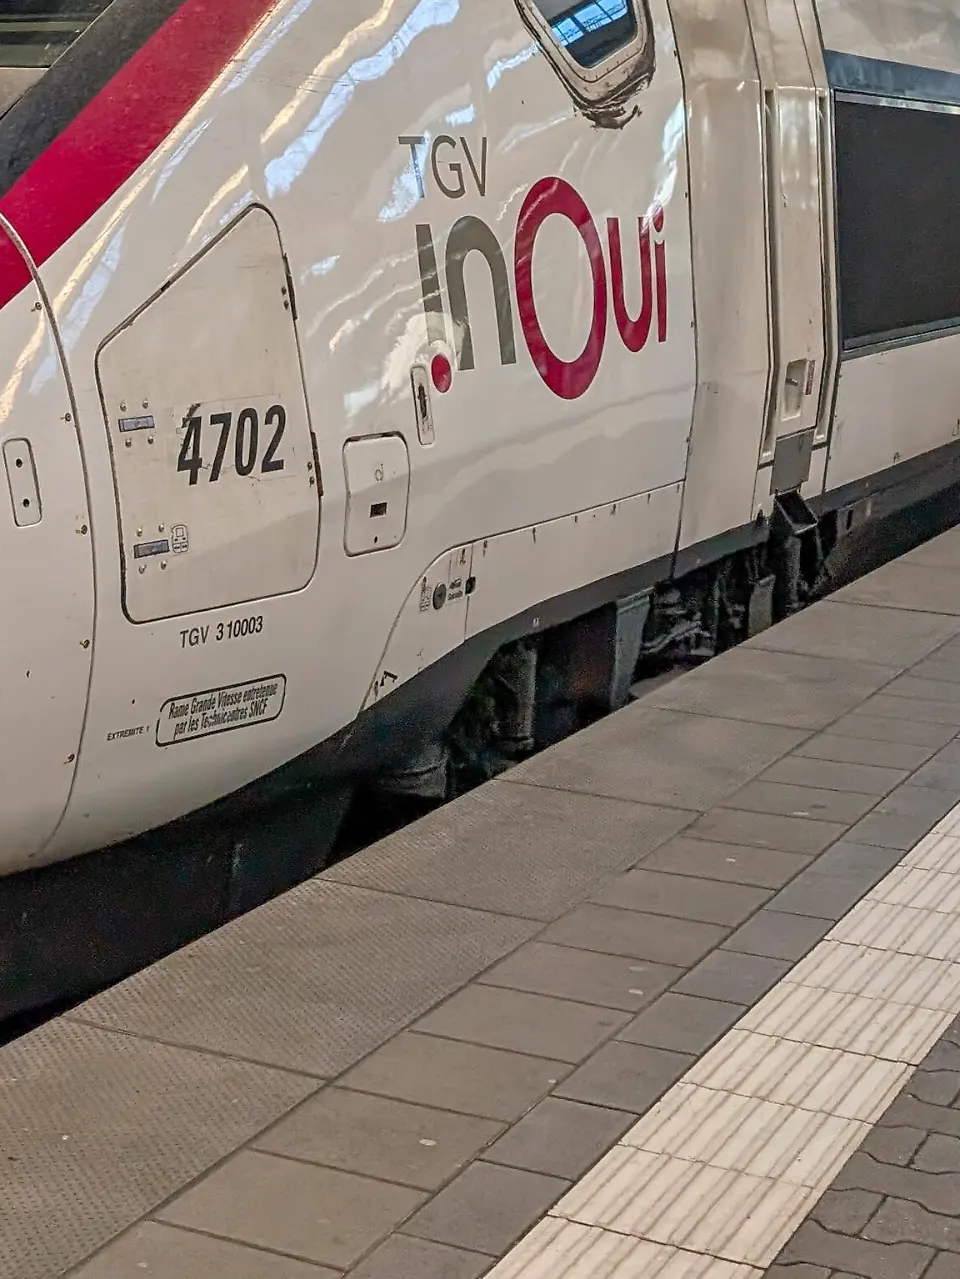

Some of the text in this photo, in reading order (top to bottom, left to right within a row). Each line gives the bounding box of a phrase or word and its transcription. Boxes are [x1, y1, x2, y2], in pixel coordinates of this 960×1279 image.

[398, 135, 487, 198] TGV
[177, 404, 286, 486] 4702
[179, 625, 210, 648] TGV
[168, 702, 189, 719] Rame
[190, 694, 216, 714] Grande
[217, 691, 243, 709] Vitesse
[173, 720, 187, 740] par
[188, 716, 199, 732] les
[248, 698, 268, 718] SNCF
